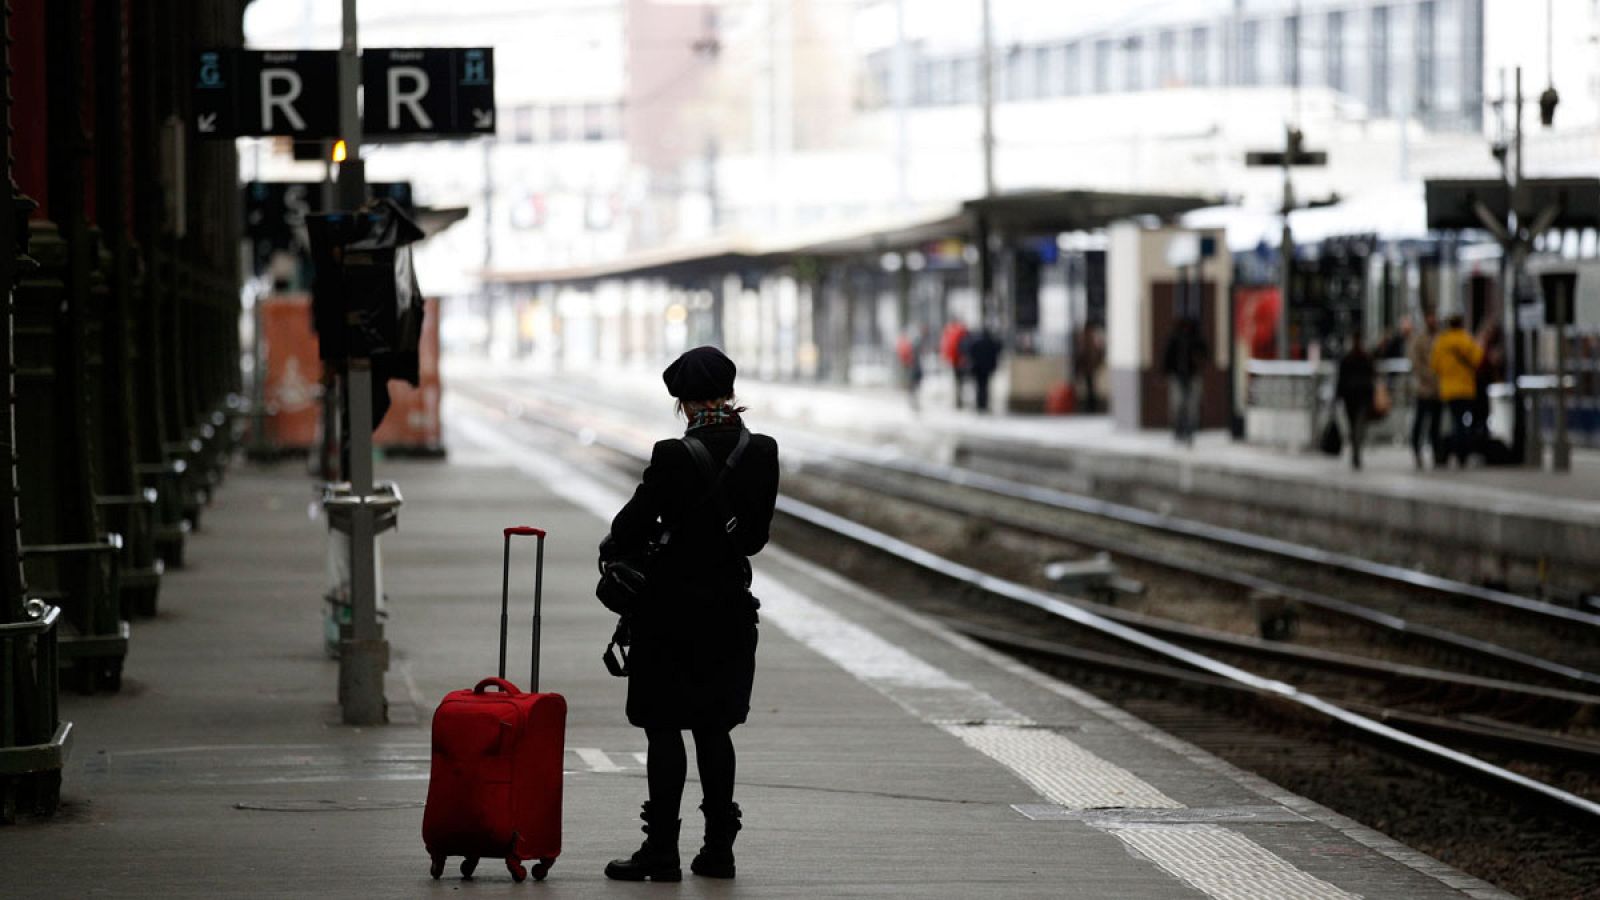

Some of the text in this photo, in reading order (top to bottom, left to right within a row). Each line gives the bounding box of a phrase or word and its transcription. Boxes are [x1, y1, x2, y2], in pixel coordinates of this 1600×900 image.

[200, 63, 220, 85] G
[464, 60, 487, 83] H
[261, 69, 305, 131] R
[388, 67, 432, 129] R
